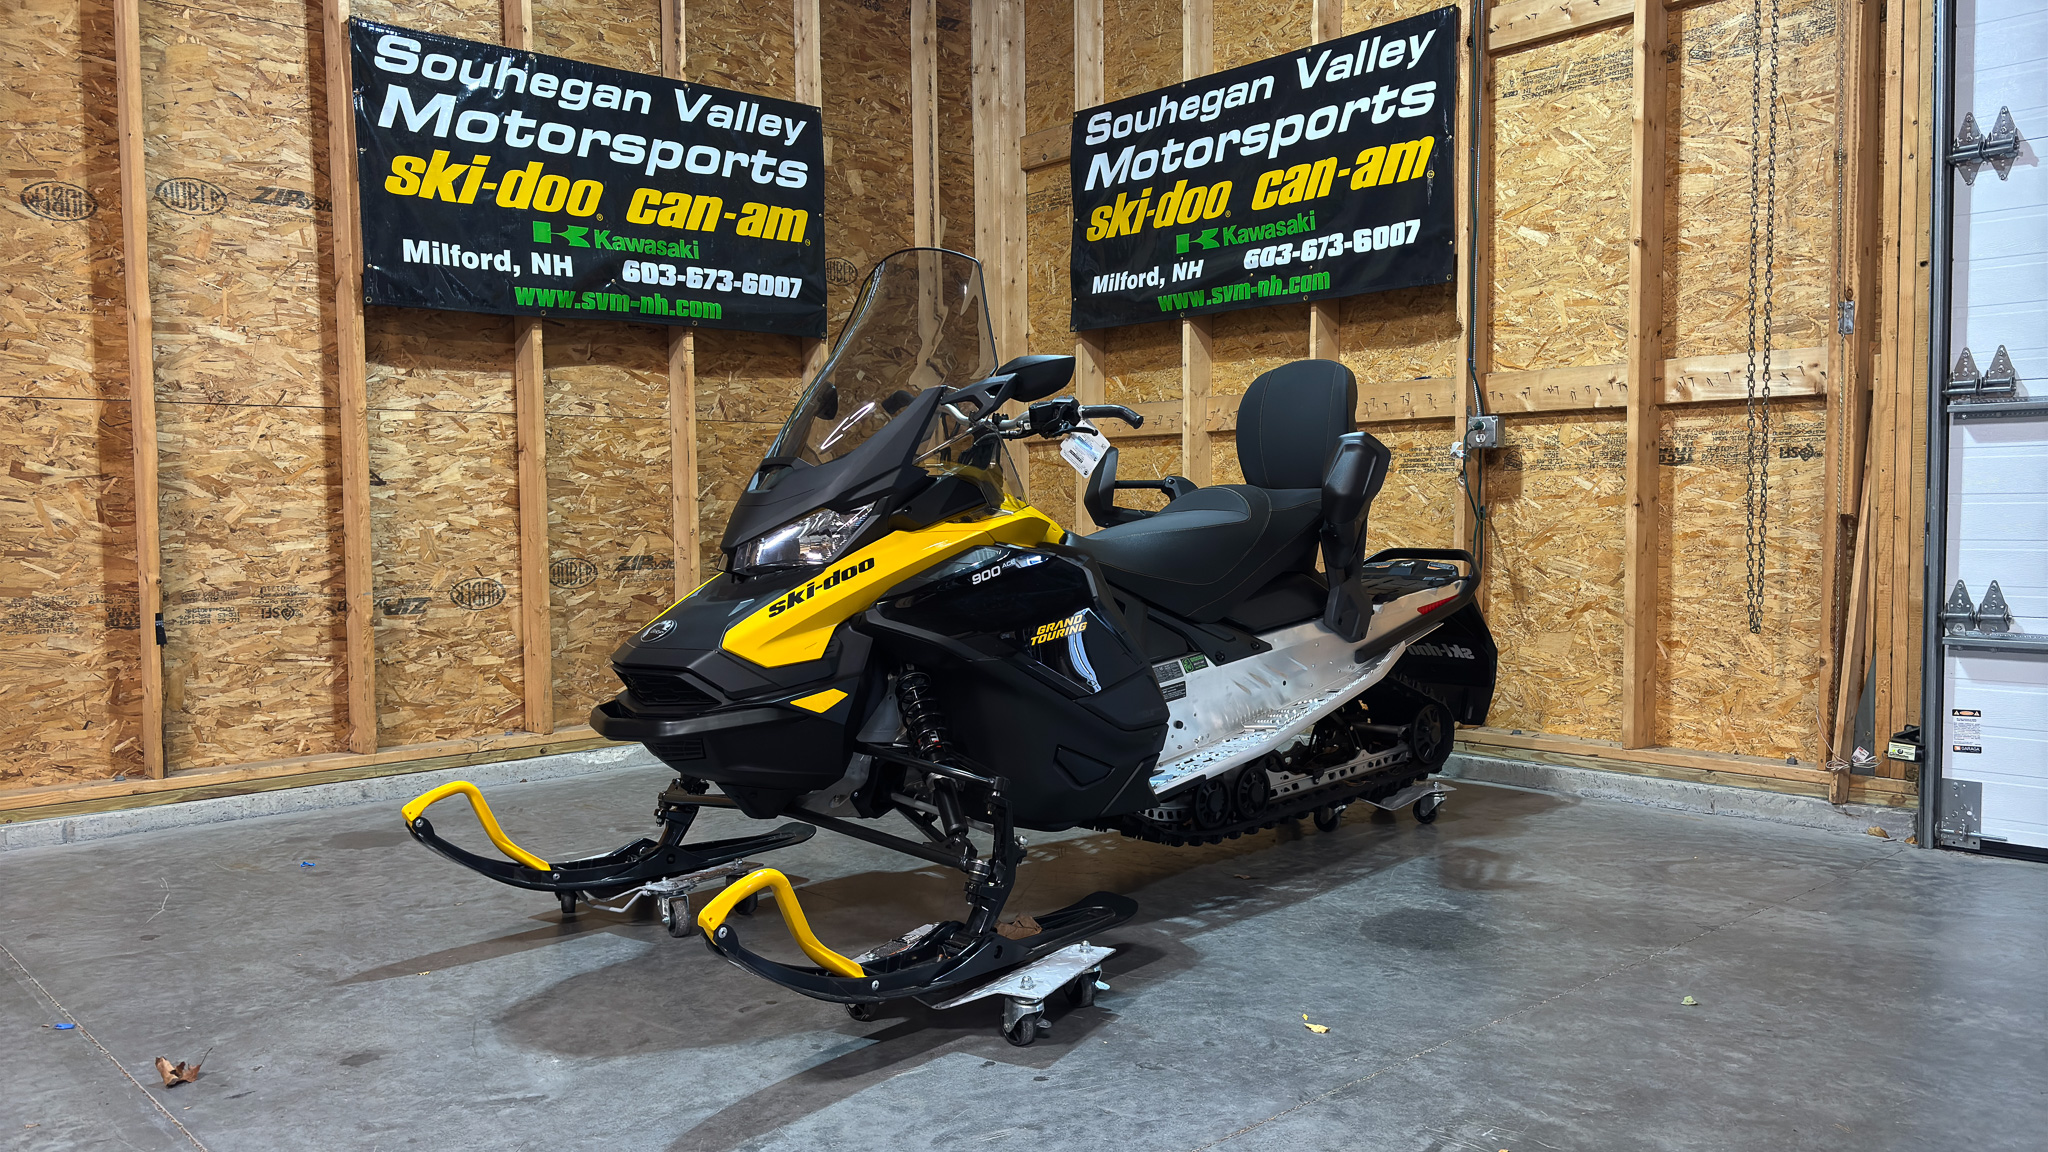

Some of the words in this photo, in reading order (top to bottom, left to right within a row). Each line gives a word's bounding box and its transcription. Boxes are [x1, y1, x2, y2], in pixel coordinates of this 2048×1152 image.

[374, 34, 651, 115] Souhegan
[674, 88, 807, 146] Valley
[1085, 75, 1275, 146] Souhegan
[1296, 28, 1437, 90] Valley
[377, 83, 808, 189] Motorsports
[1084, 80, 1437, 191] Motorsports
[158, 180, 222, 213] HUBER
[384, 149, 604, 218] ski-doo
[625, 187, 809, 243] can-am
[1086, 178, 1233, 242] ski-doo
[1251, 135, 1435, 211] can-am
[593, 229, 700, 260] Kawasaki
[1222, 210, 1316, 247] Kawasaki
[1243, 219, 1421, 270] 603-673-6007
[402, 239, 521, 278] Milford,
[530, 252, 574, 278] NH
[1091, 266, 1166, 295] Milford,
[1171, 259, 1205, 283] NH
[621, 259, 803, 299] 603-673-6007
[1157, 271, 1331, 312] www.svm-nh.com
[514, 286, 723, 320] www.svm-nh.com
[768, 557, 875, 618] ski-doo
[972, 565, 1001, 585] 900
[1001, 558, 1017, 568] ACE
[1030, 621, 1088, 646] TOURING
[1036, 614, 1083, 636] GRAND
